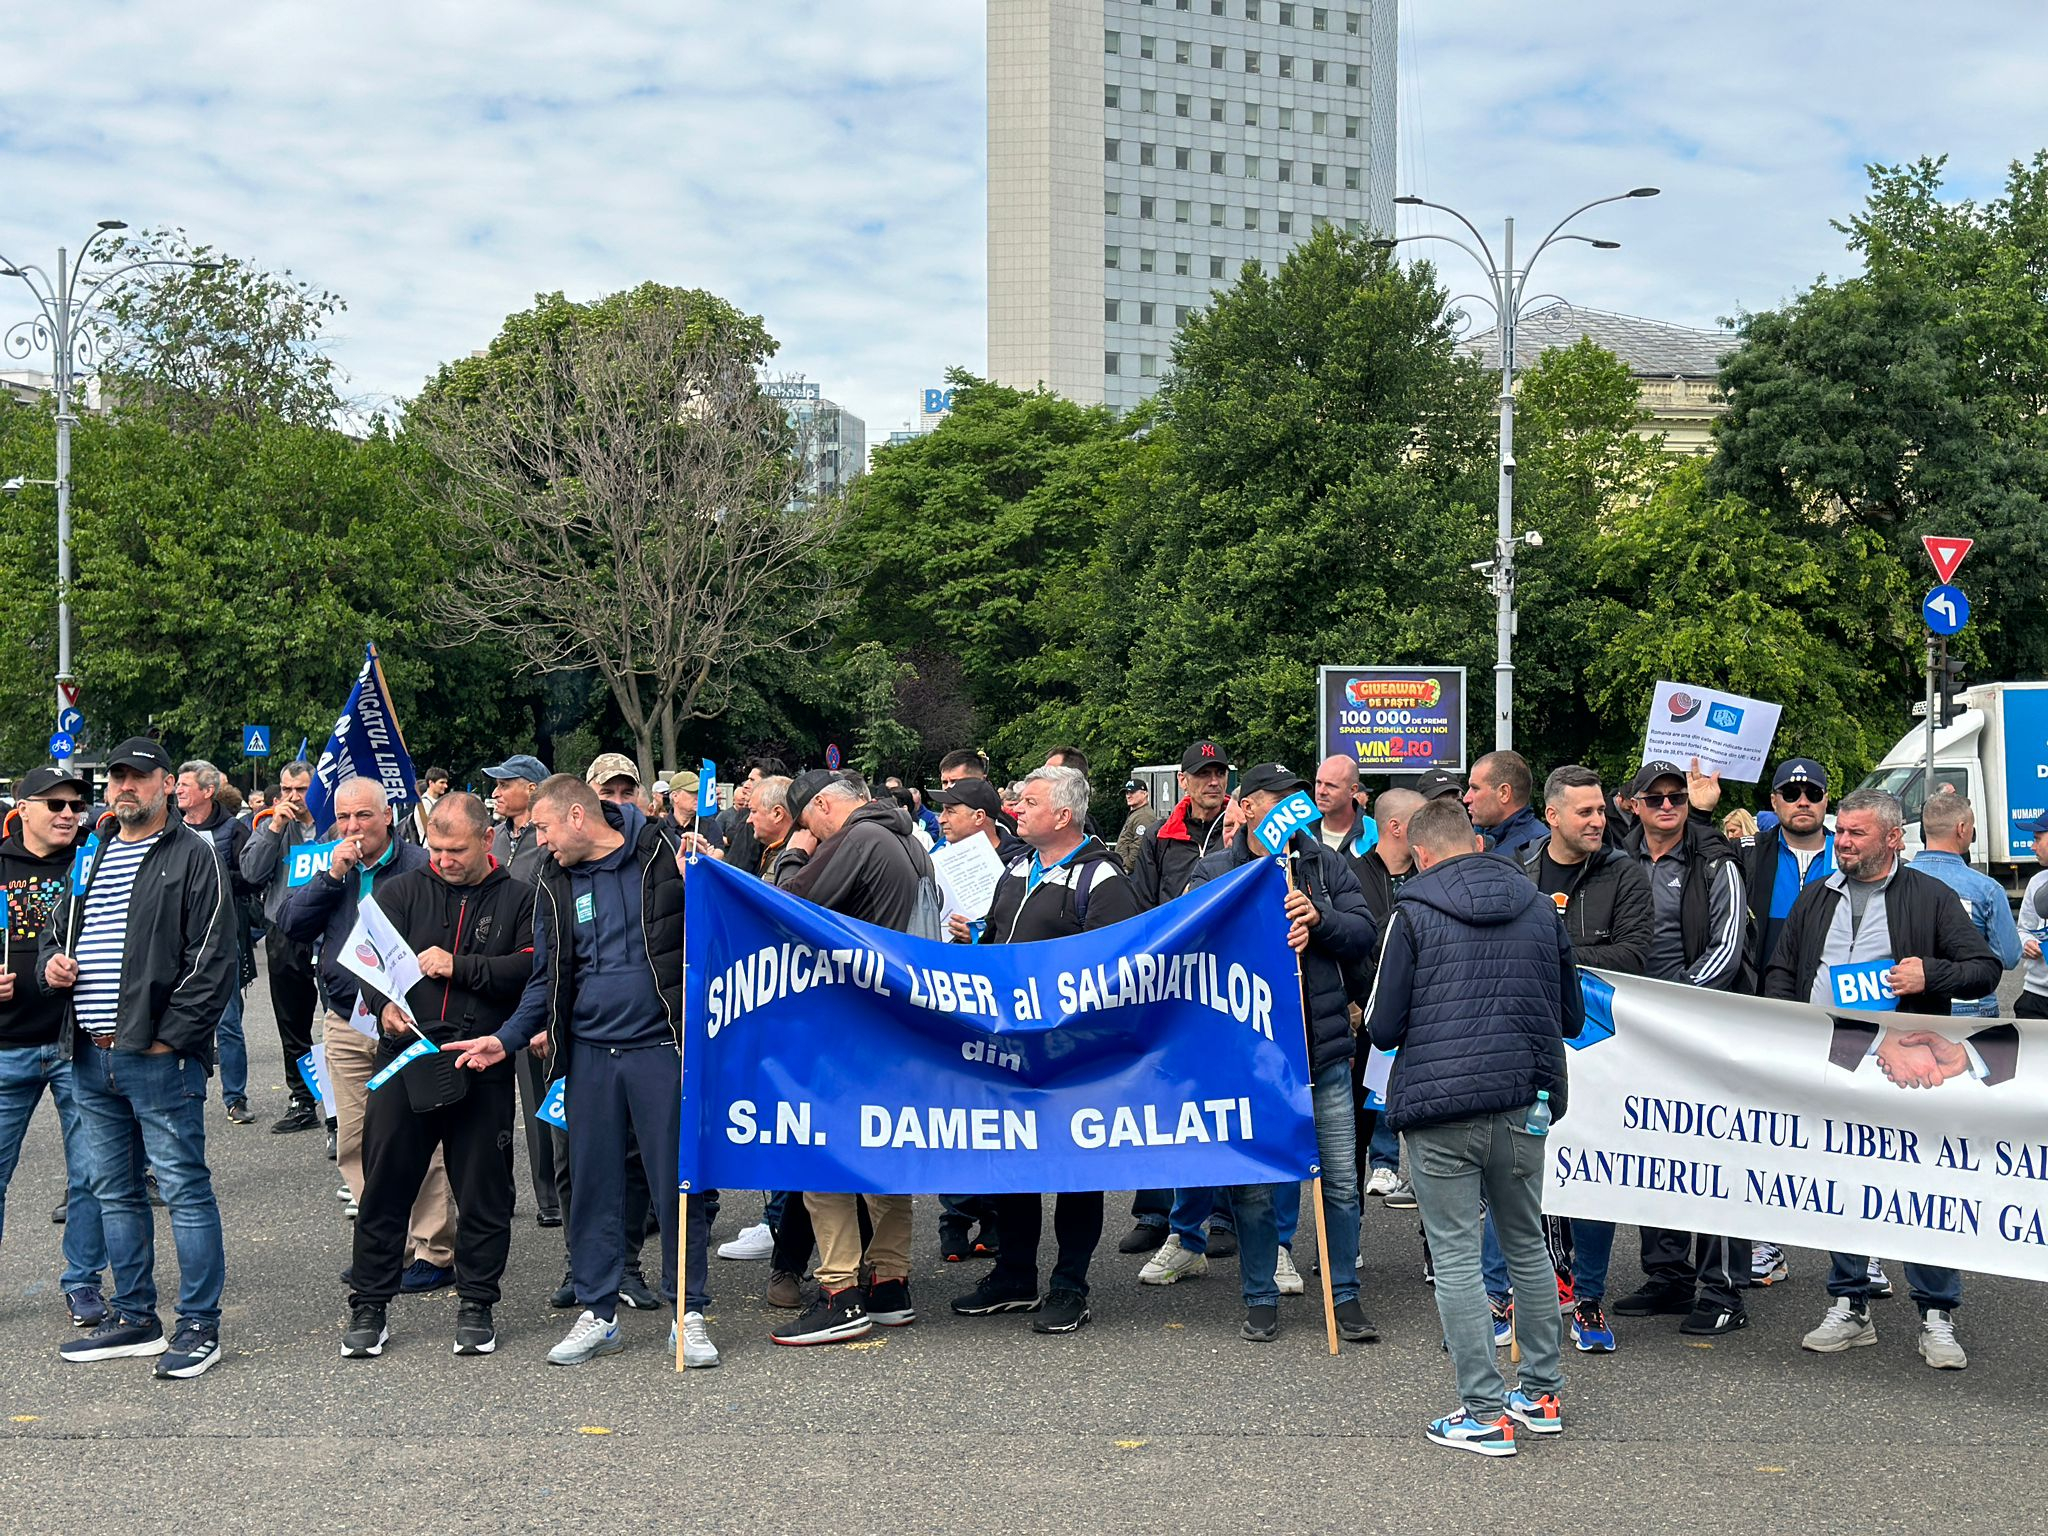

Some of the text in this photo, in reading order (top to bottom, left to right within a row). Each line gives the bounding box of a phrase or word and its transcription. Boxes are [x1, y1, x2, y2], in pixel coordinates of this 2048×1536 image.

[1360, 683, 1426, 696] GIVEAWAY
[1368, 699, 1382, 708] DE
[1339, 710, 1371, 725] 100
[1375, 710, 1411, 725] 000
[1339, 726, 1448, 734] SPARGE PRIMUL OU CU NOI
[1355, 736, 1433, 757] WIN2.RO
[375, 752, 408, 801] LIBER
[1263, 798, 1312, 849] BNS
[707, 942, 1275, 1041] SINDICATUL LIBER al SALARIATILOR
[961, 1040, 1021, 1072] din
[726, 1097, 1253, 1150] S.N. DAMEN GALATI
[1623, 1094, 1809, 1149] SINDICATUL
[1823, 1118, 1921, 1165] LIBER
[1935, 1136, 1981, 1172] AL
[1745, 1169, 1845, 1216] NAVAL
[1861, 1185, 1983, 1236] DAMEN
